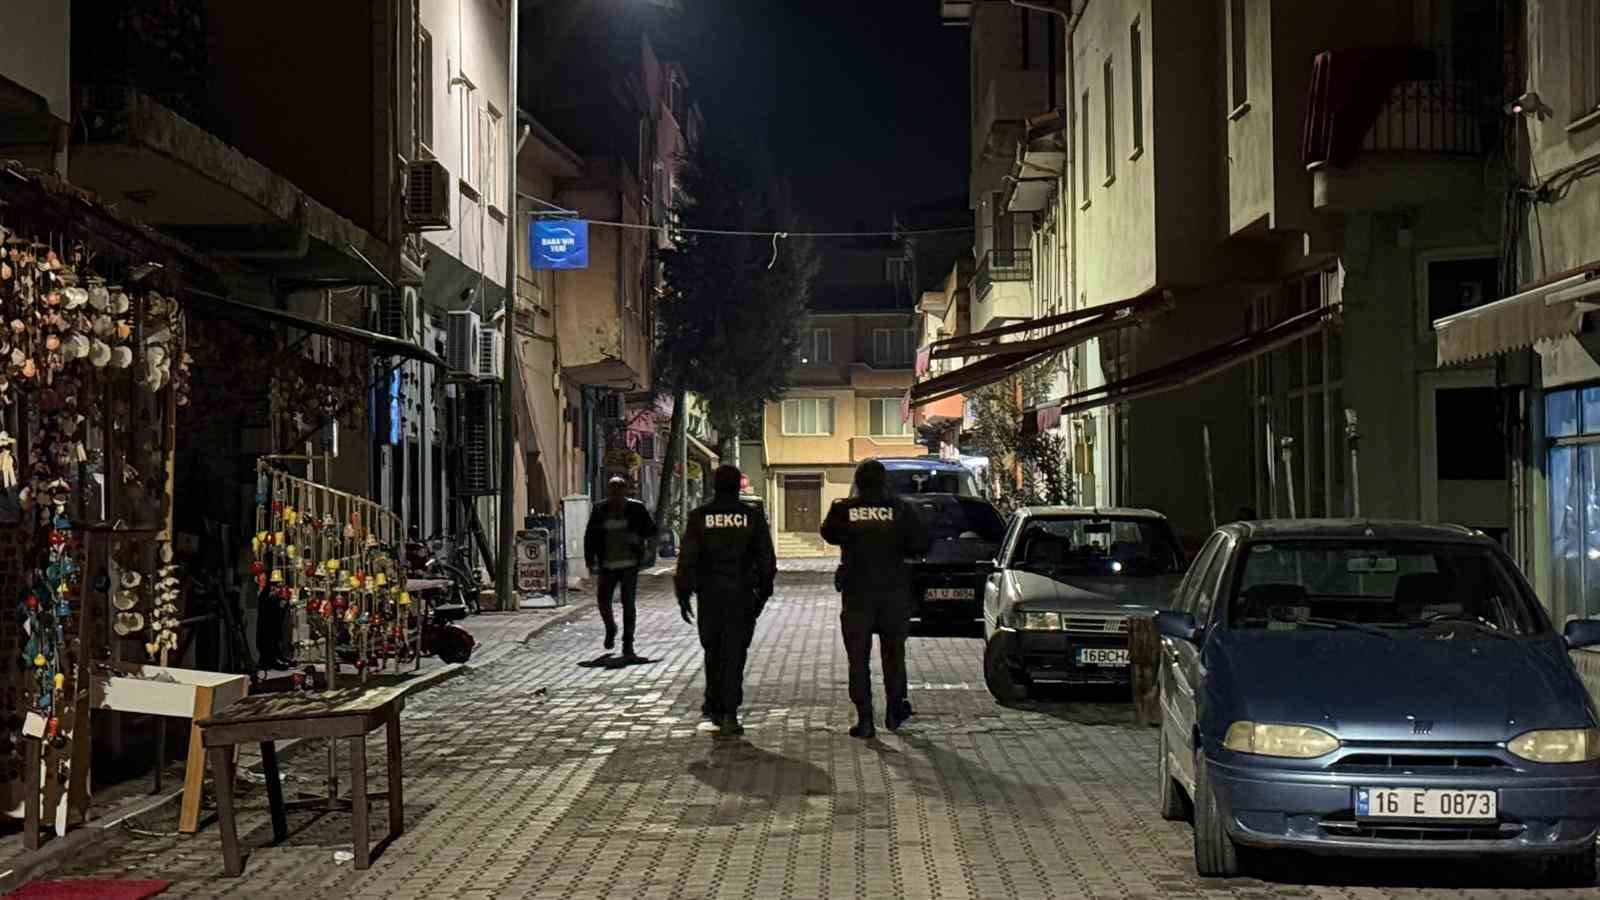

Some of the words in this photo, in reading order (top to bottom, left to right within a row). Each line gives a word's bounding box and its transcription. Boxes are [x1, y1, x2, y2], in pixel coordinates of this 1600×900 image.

[1376, 792, 1398, 813] 16
[1414, 793, 1425, 814] E
[1440, 793, 1490, 815] 0873
